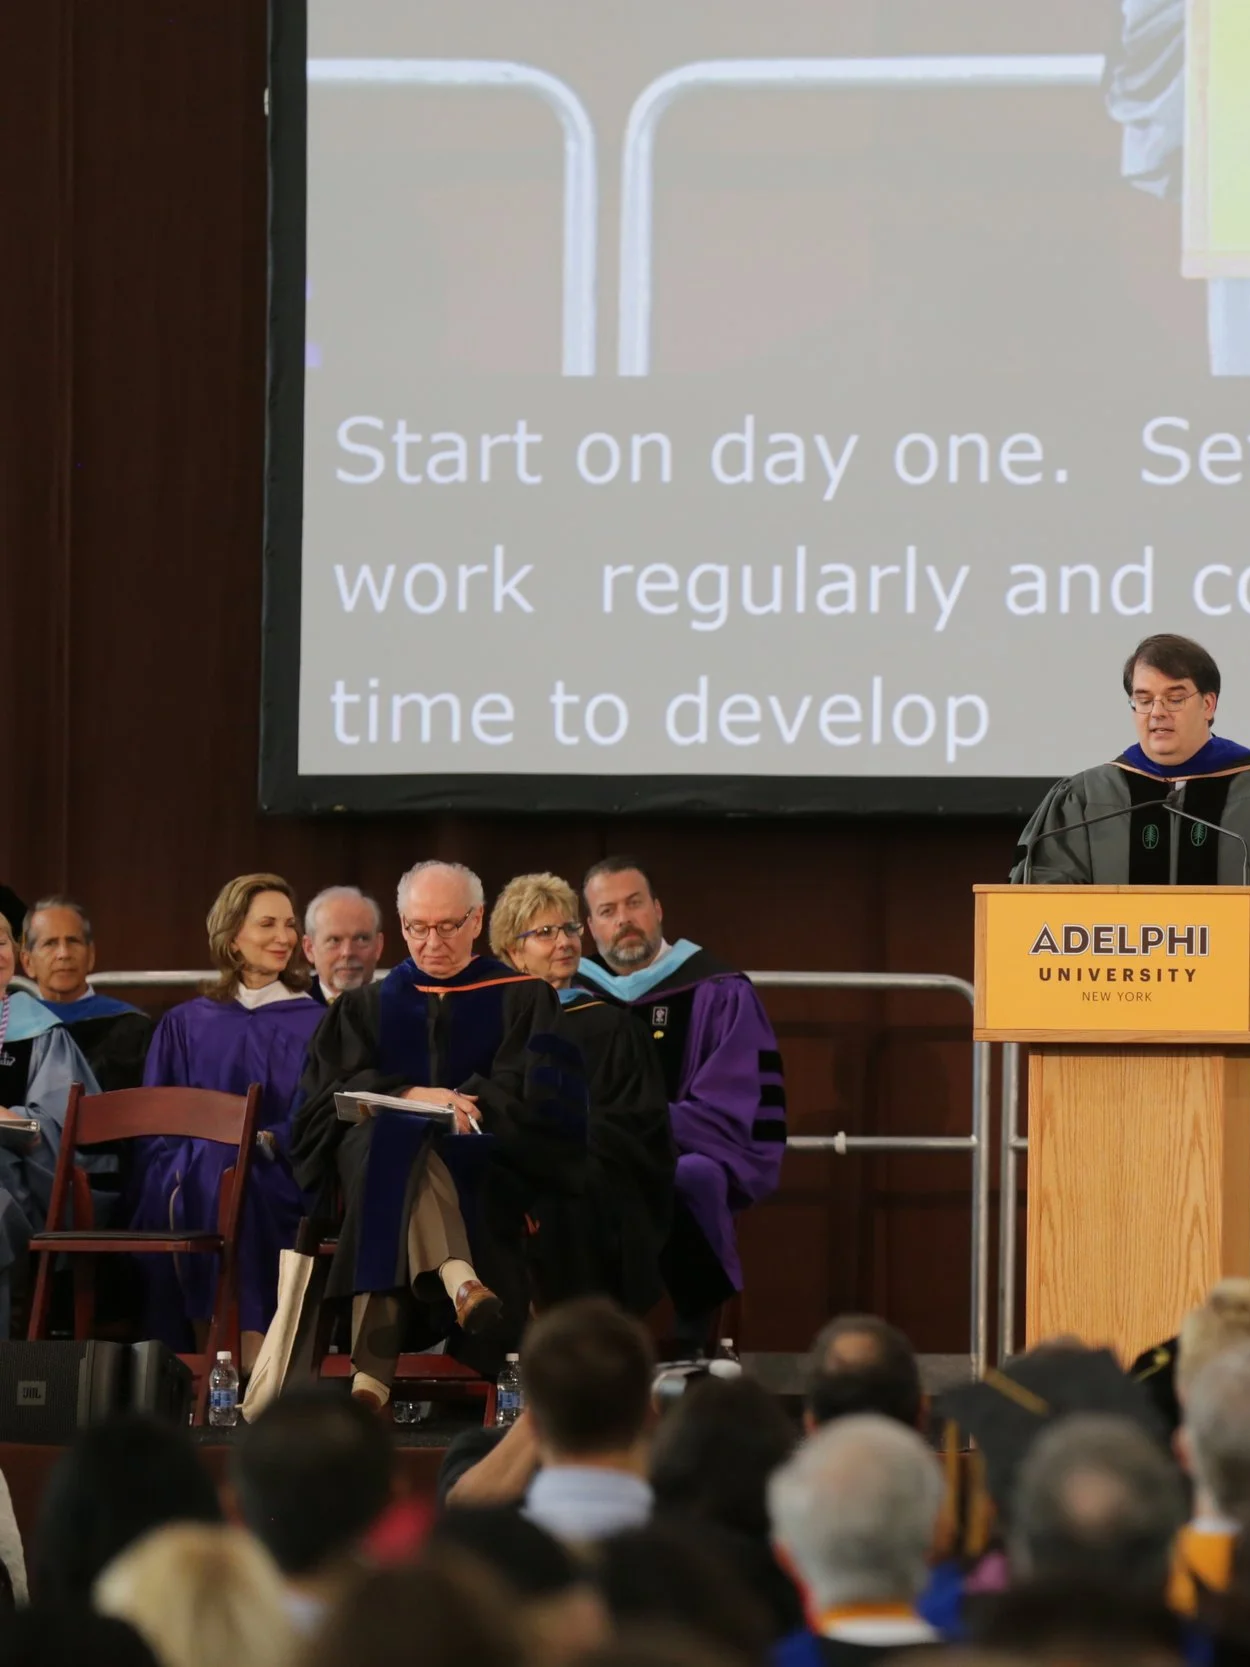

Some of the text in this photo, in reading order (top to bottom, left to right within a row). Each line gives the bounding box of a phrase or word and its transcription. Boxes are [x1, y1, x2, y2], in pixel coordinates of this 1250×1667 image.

[337, 416, 544, 486] Start
[577, 433, 673, 486] on
[712, 415, 860, 502] day
[895, 433, 1069, 486] one.
[334, 545, 535, 616] work
[603, 546, 971, 633] regularly
[1006, 546, 1155, 617] and
[331, 676, 990, 764] time to develop
[1028, 922, 1210, 956] ADELPHI
[1039, 967, 1197, 982] UNIVERSITY
[1082, 991, 1152, 1002] NEW YORK
